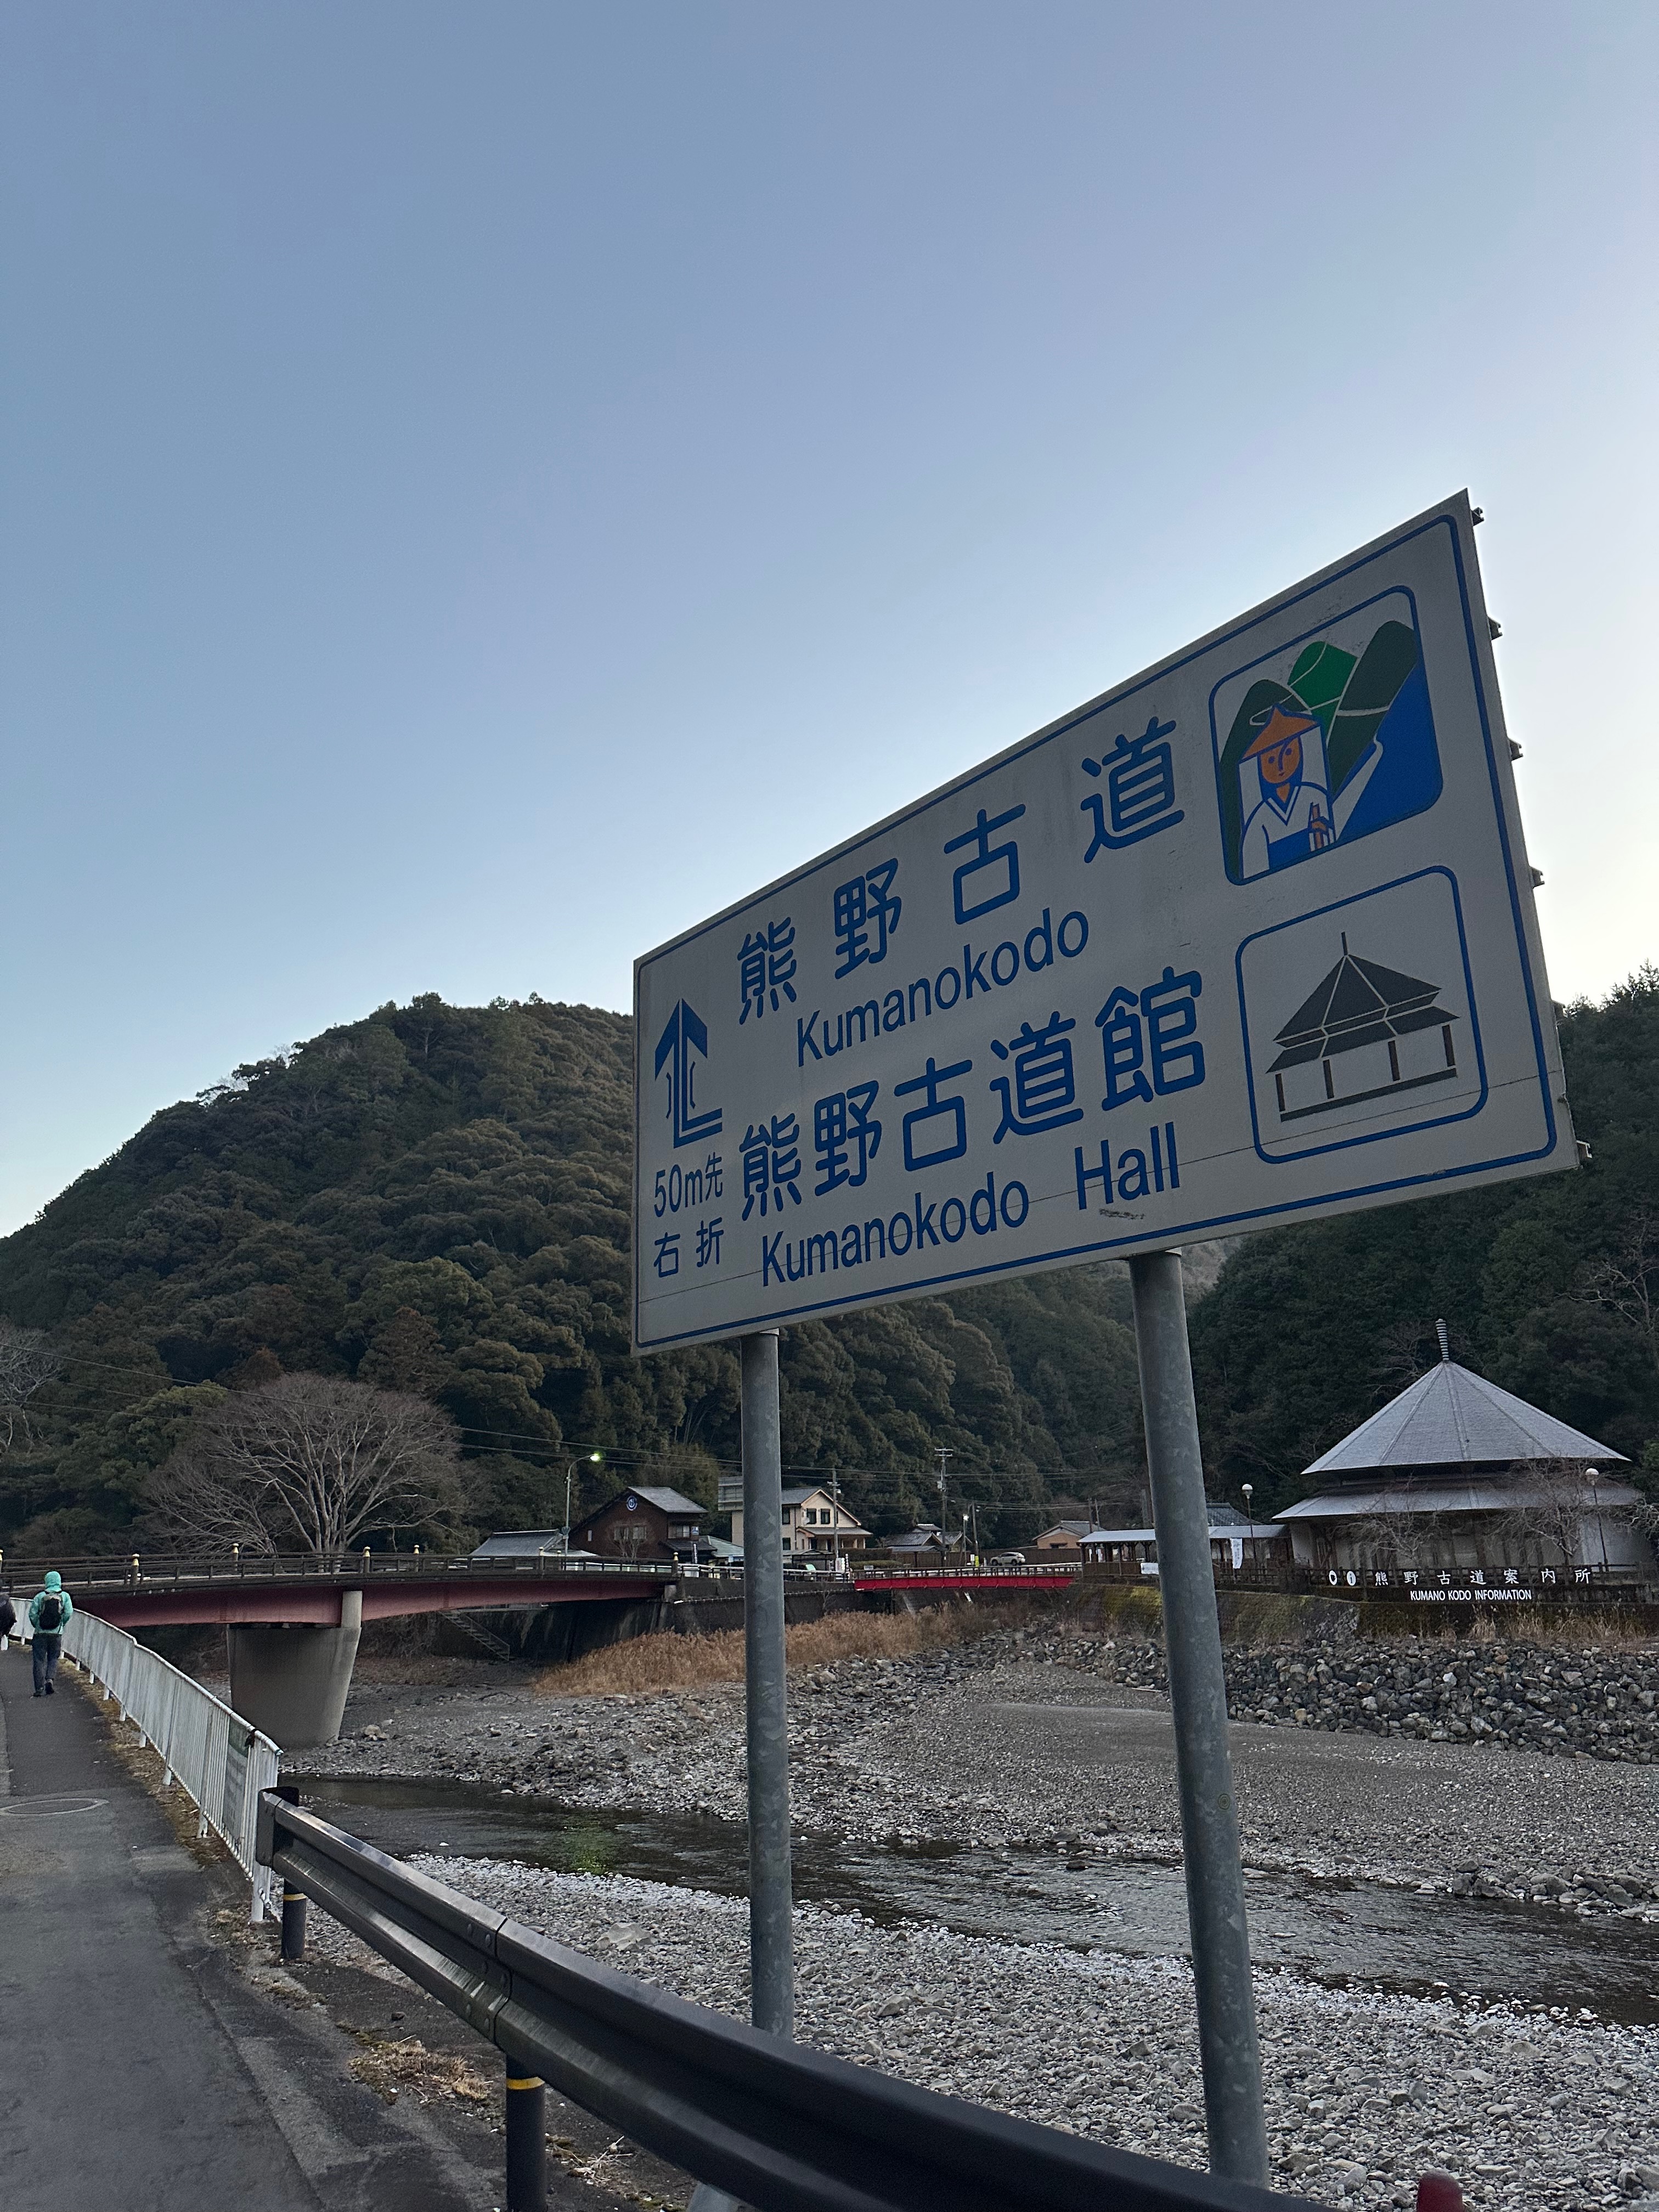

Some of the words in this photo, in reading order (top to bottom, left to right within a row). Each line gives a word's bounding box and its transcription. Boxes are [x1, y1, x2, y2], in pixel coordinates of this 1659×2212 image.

[738, 715, 1185, 1025] 熊野古道
[798, 907, 1089, 1067] Kumanokodo
[738, 966, 1206, 1221] 熊野古道館
[654, 1152, 723, 1218] 50m先
[762, 1172, 1029, 1285] Kumanokodo
[1075, 1121, 1180, 1210] Hall
[653, 1216, 724, 1278] 右折
[1375, 1568, 1590, 1585] 熊野古道案内所
[1410, 1590, 1446, 1601] KUMANO
[1448, 1590, 1471, 1601] KODO
[1475, 1589, 1532, 1600] INFORMATION
